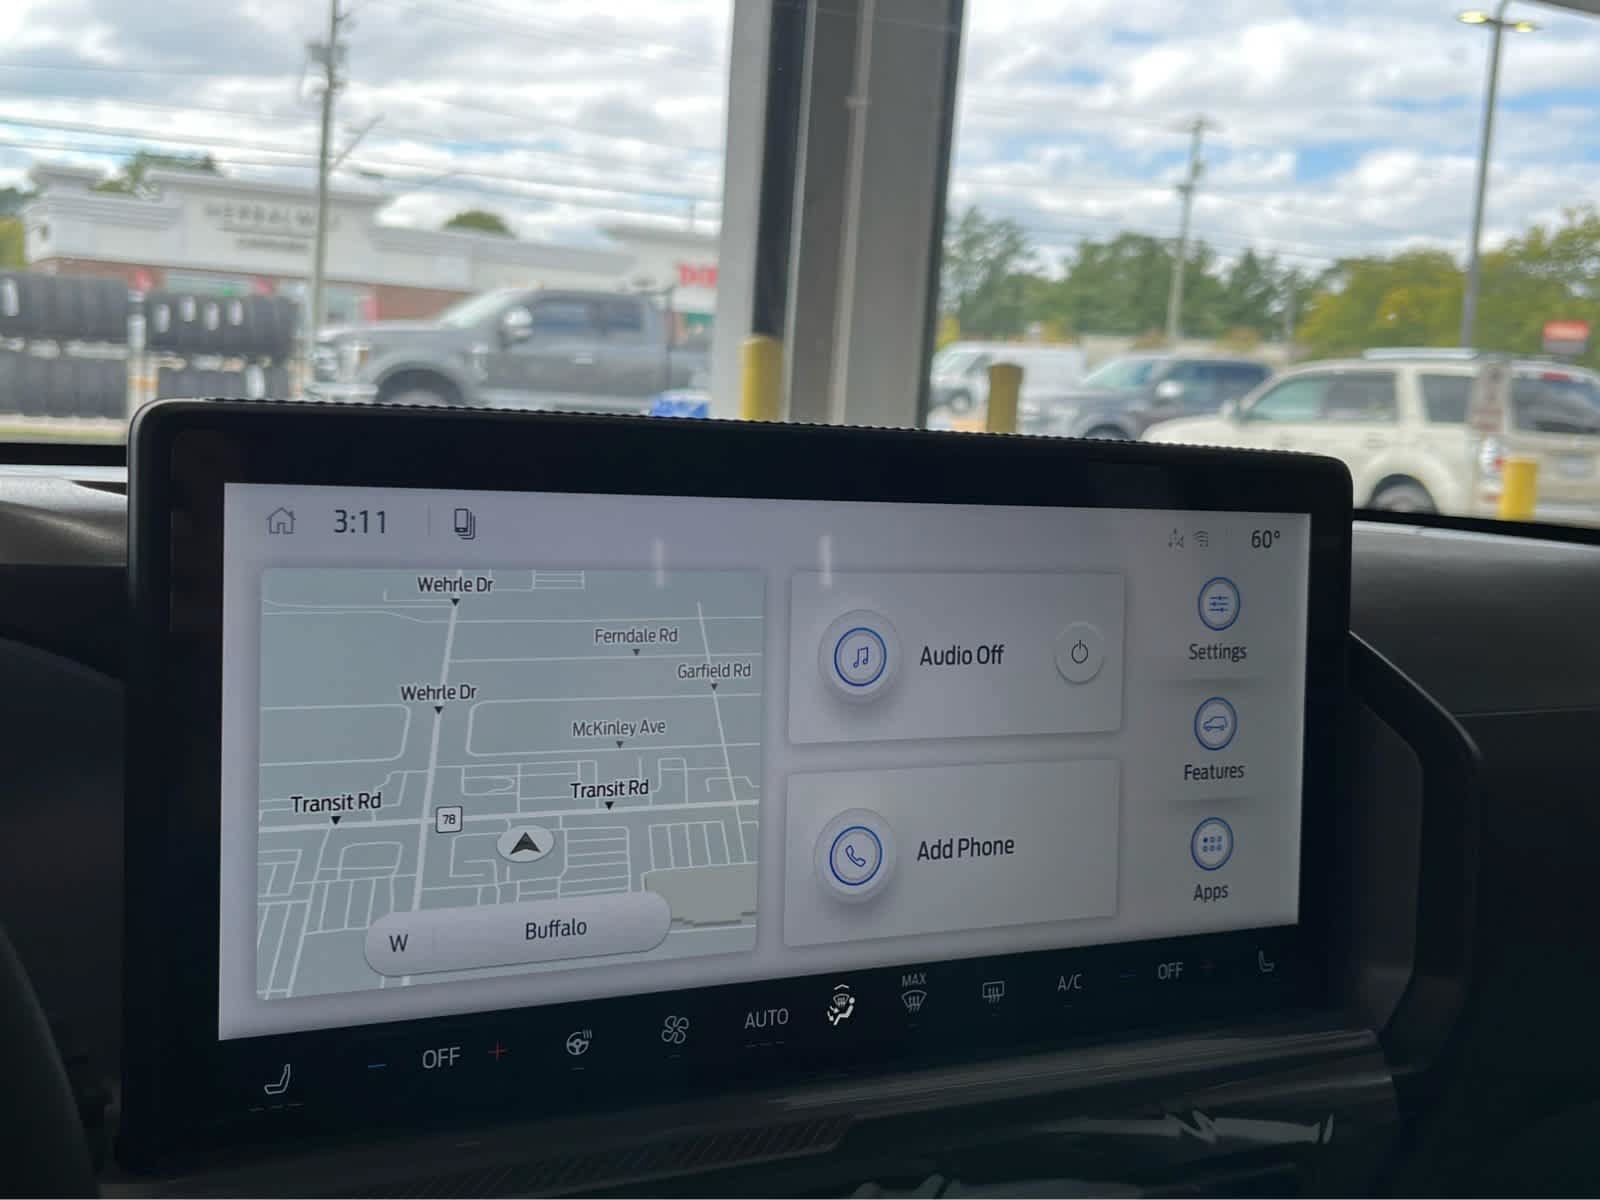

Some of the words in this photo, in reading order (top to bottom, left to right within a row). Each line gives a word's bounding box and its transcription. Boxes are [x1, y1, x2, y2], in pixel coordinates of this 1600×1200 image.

[334, 509, 387, 533] 3:11
[417, 577, 473, 592] Wehrle
[476, 577, 493, 592] Dr
[595, 628, 656, 643] Ferndale
[660, 628, 678, 642] Rd
[920, 647, 972, 666] Audio
[976, 645, 1004, 665] Off
[1188, 644, 1247, 662] Settings
[678, 664, 730, 679] Garfield
[734, 664, 751, 677] Rd
[401, 686, 456, 700] Wehrle
[460, 685, 476, 699] Dr
[572, 720, 636, 736] McKinley
[640, 720, 666, 734] Ave
[1184, 764, 1244, 780] Features
[571, 782, 625, 798] Transit
[629, 780, 649, 796] Rd
[291, 796, 354, 813] Transit
[358, 792, 381, 810] Rd
[442, 814, 456, 825] 78
[917, 838, 954, 861] Add
[958, 836, 1015, 857] Phone
[1193, 884, 1229, 902] Apps
[525, 919, 587, 941] Buffalo
[389, 934, 408, 951] W
[902, 973, 927, 986] MAX
[1158, 963, 1183, 980] OFF
[1058, 973, 1082, 991] A/C
[745, 1008, 789, 1028] AUTO
[422, 1047, 461, 1069] OFF
